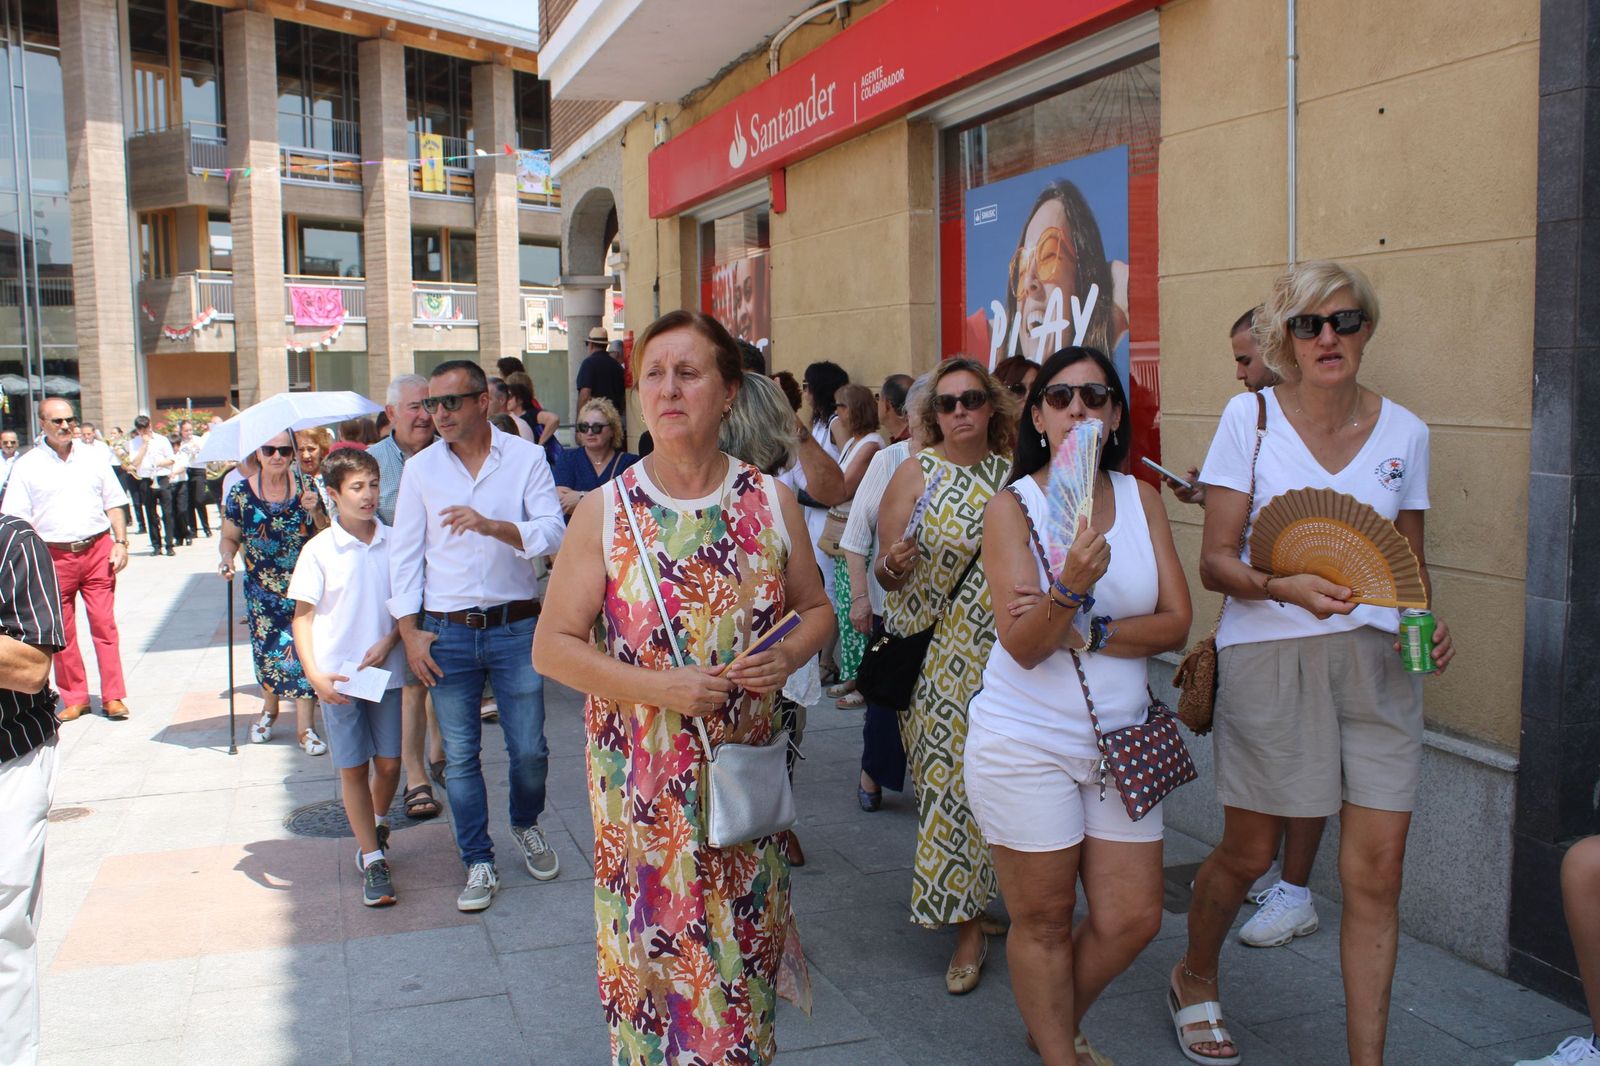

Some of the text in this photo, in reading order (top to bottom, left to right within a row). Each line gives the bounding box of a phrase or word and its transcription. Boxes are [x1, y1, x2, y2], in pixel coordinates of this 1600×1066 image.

[861, 66, 884, 88] AGENTE
[861, 68, 904, 101] COLABORADOR
[750, 73, 836, 158] Santander
